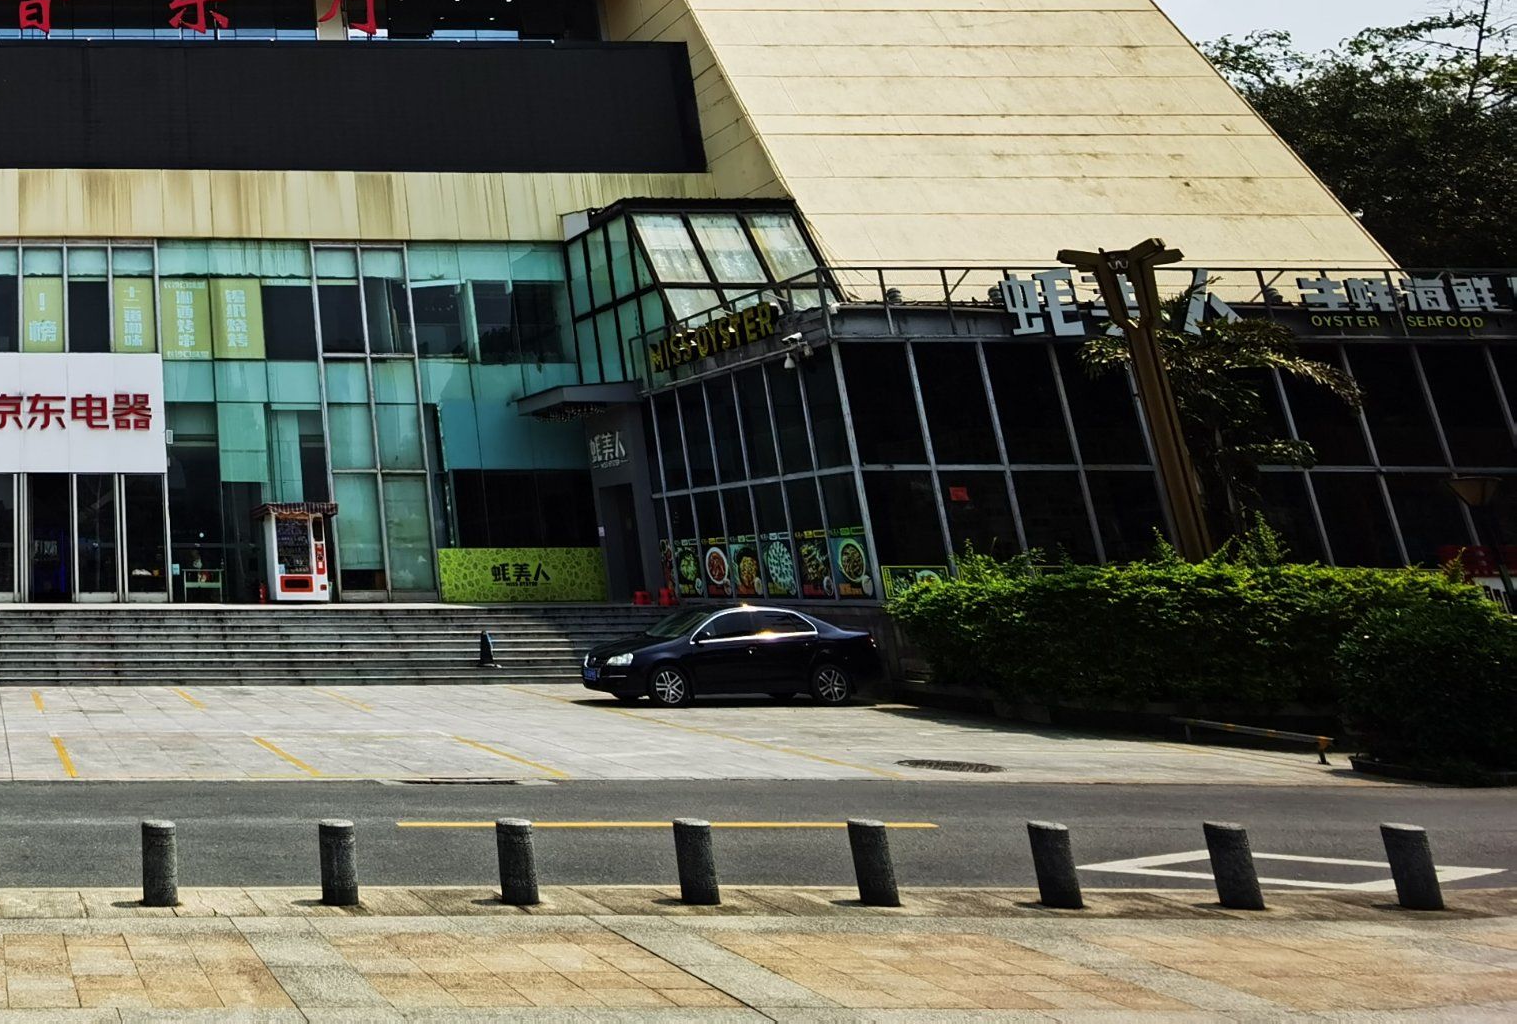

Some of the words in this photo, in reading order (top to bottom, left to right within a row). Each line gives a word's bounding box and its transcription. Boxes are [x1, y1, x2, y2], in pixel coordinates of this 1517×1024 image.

[1311, 315, 1379, 327] OYSTER
[1406, 315, 1484, 329] SEAFOOD
[491, 562, 551, 582] 蚝美人
